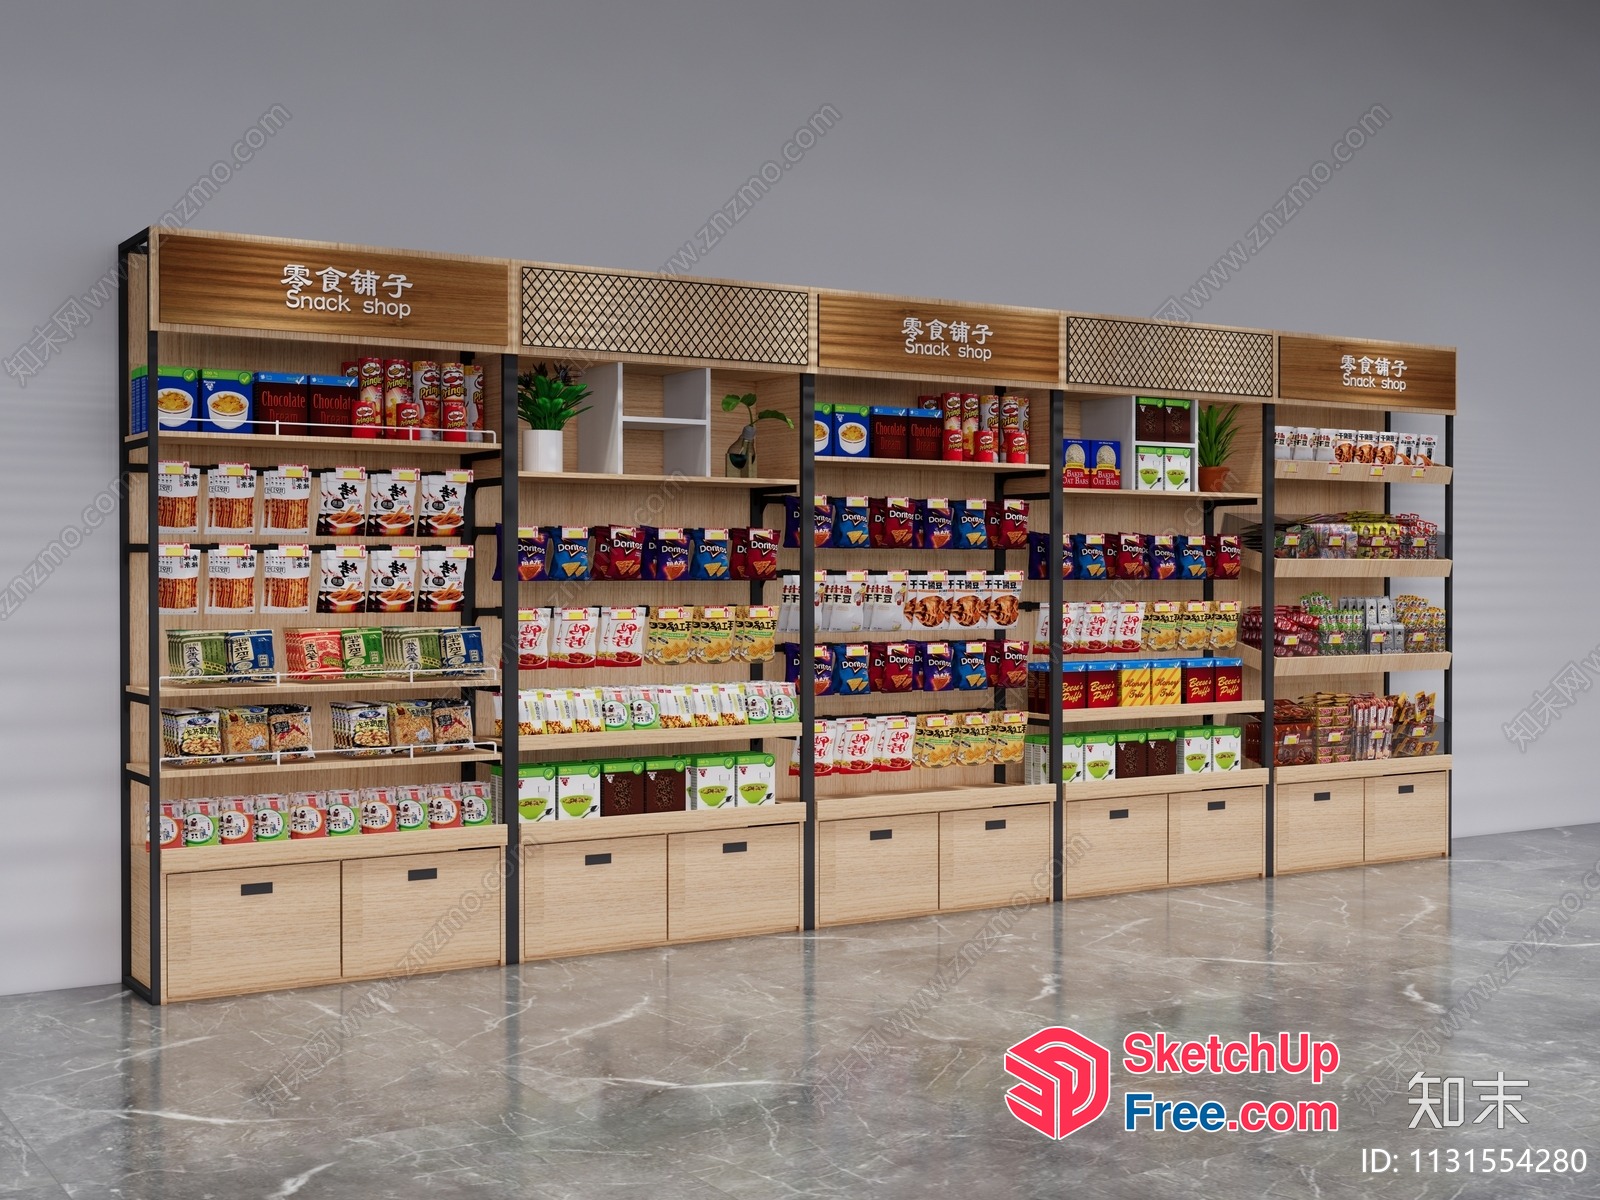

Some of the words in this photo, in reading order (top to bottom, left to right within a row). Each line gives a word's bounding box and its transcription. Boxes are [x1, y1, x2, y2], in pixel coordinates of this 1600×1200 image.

[281, 264, 414, 299] 零食铺子
[286, 289, 352, 312] Snack
[363, 298, 411, 319] shop
[901, 317, 994, 345] 零食铺子
[904, 338, 951, 356] Snack
[958, 344, 992, 362] shop
[1340, 355, 1408, 377] 零食铺子
[1342, 372, 1376, 388] Snack
[1381, 377, 1407, 392] shop
[261, 391, 306, 408] Chocolate
[320, 410, 349, 424] Dream
[875, 421, 906, 436] Chocolate
[911, 424, 941, 437] Chocolate
[1066, 469, 1084, 478] BAKER
[1098, 471, 1115, 479] BAKER
[1075, 477, 1089, 485] BARS
[1093, 478, 1105, 486] OAT
[1106, 478, 1120, 486] BARS
[889, 510, 914, 520] Doritos
[558, 543, 588, 553] Doritos
[613, 540, 643, 550] Doritos
[662, 545, 688, 555] Doritos
[700, 545, 727, 554] Doritos
[751, 541, 778, 551] Doritos
[889, 655, 914, 665] Doritos
